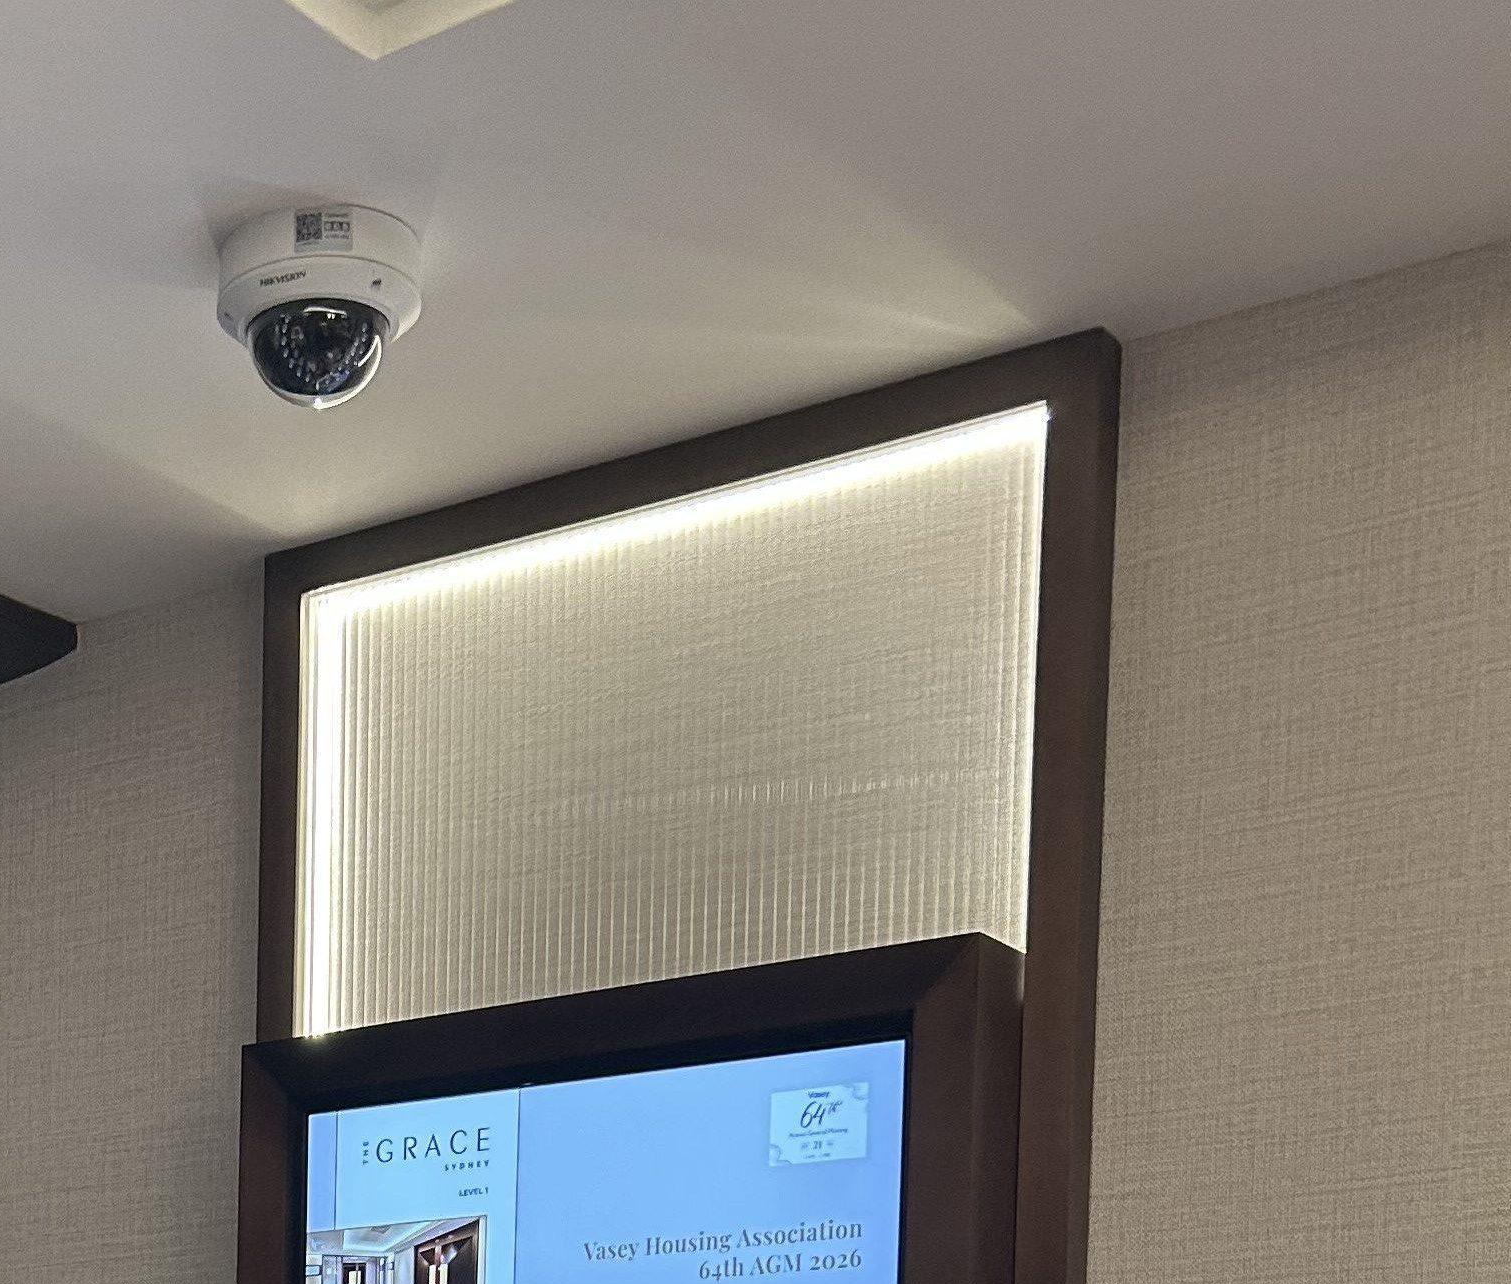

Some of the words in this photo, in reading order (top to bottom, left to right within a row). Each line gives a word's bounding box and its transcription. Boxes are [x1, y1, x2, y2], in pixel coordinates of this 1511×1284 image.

[376, 1127, 490, 1163] GRACE
[444, 1160, 489, 1172] SYDNEY
[458, 1188, 483, 1197] LEVEL
[583, 1241, 639, 1261] Vasey
[645, 1230, 731, 1256] Housing
[736, 1219, 863, 1248] Association
[698, 1257, 743, 1281] 64th
[749, 1253, 802, 1276] AGM
[809, 1249, 863, 1272] 2026
